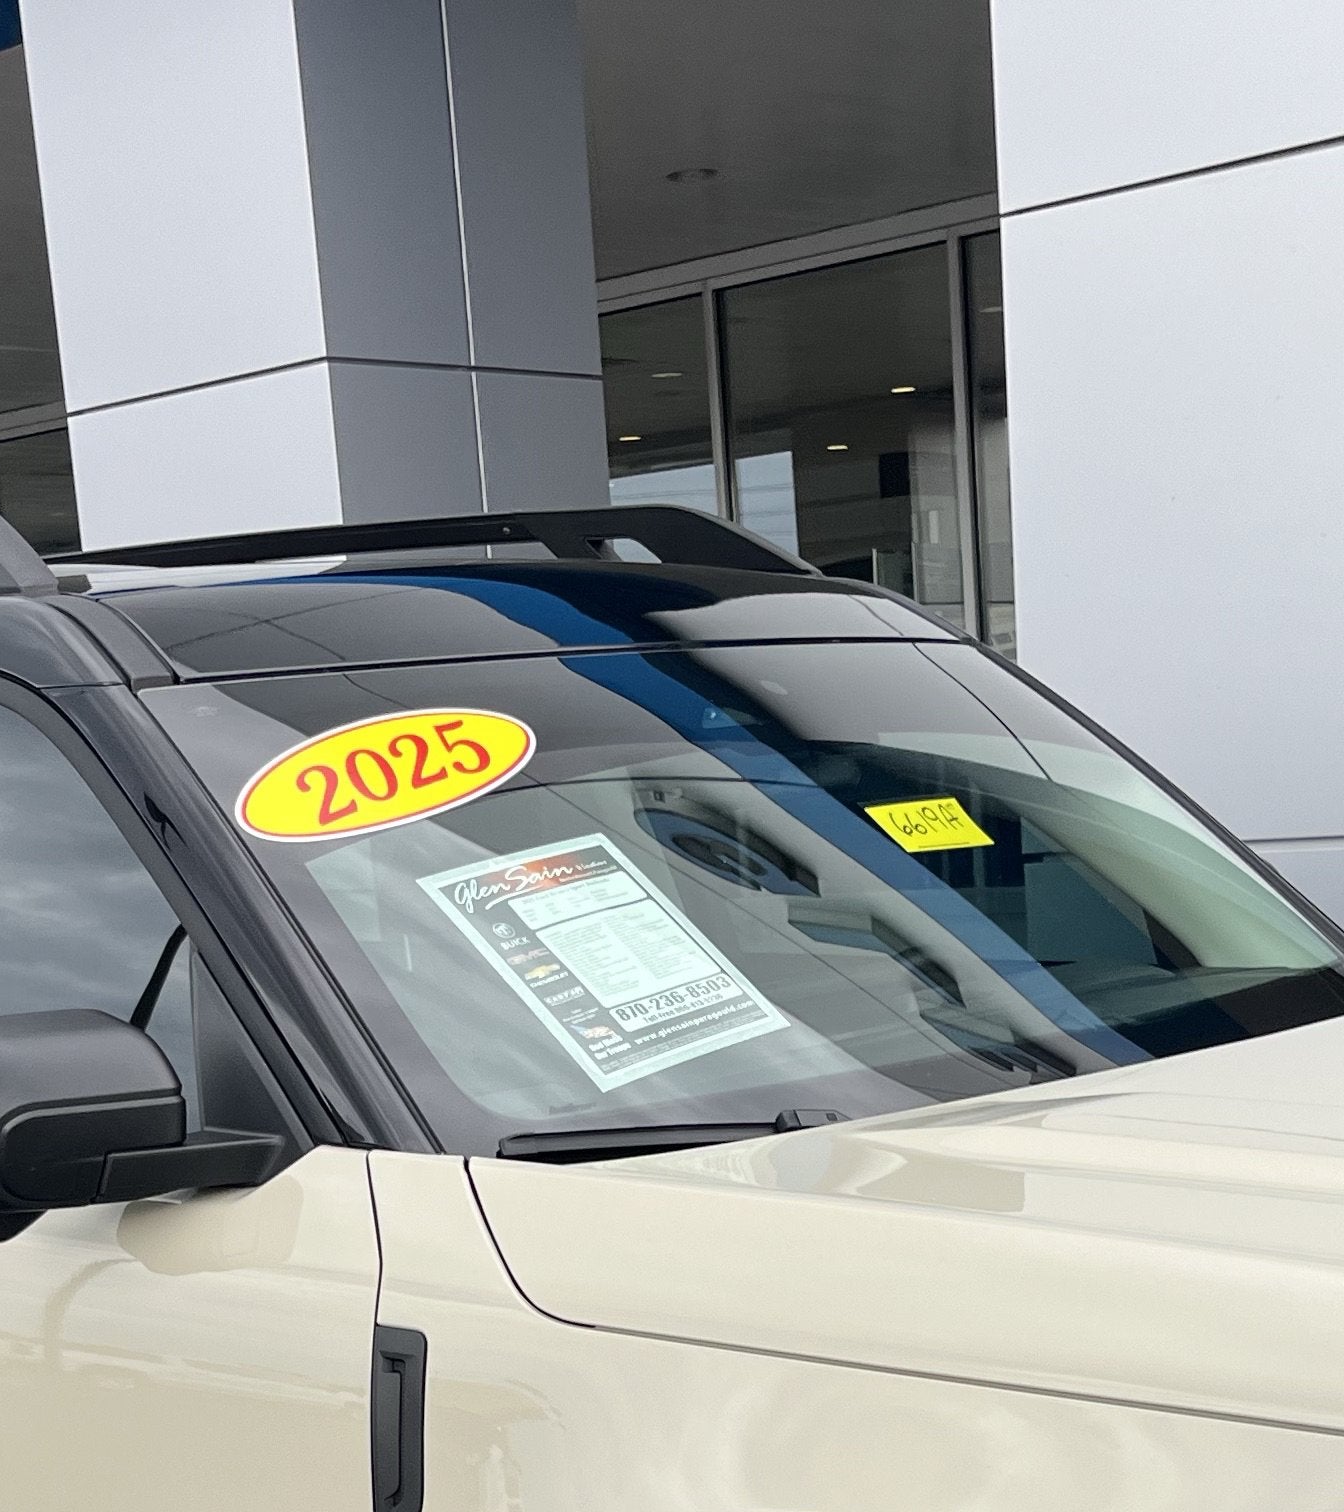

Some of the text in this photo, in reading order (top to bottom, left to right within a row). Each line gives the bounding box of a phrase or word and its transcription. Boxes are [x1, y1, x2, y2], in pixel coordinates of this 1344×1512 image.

[296, 720, 491, 826] 2025
[889, 803, 965, 838] 6619A
[455, 879, 510, 914] Glen
[505, 865, 574, 892] Sain
[500, 936, 531, 951] BUICK
[615, 976, 732, 1022] 870-236-8503
